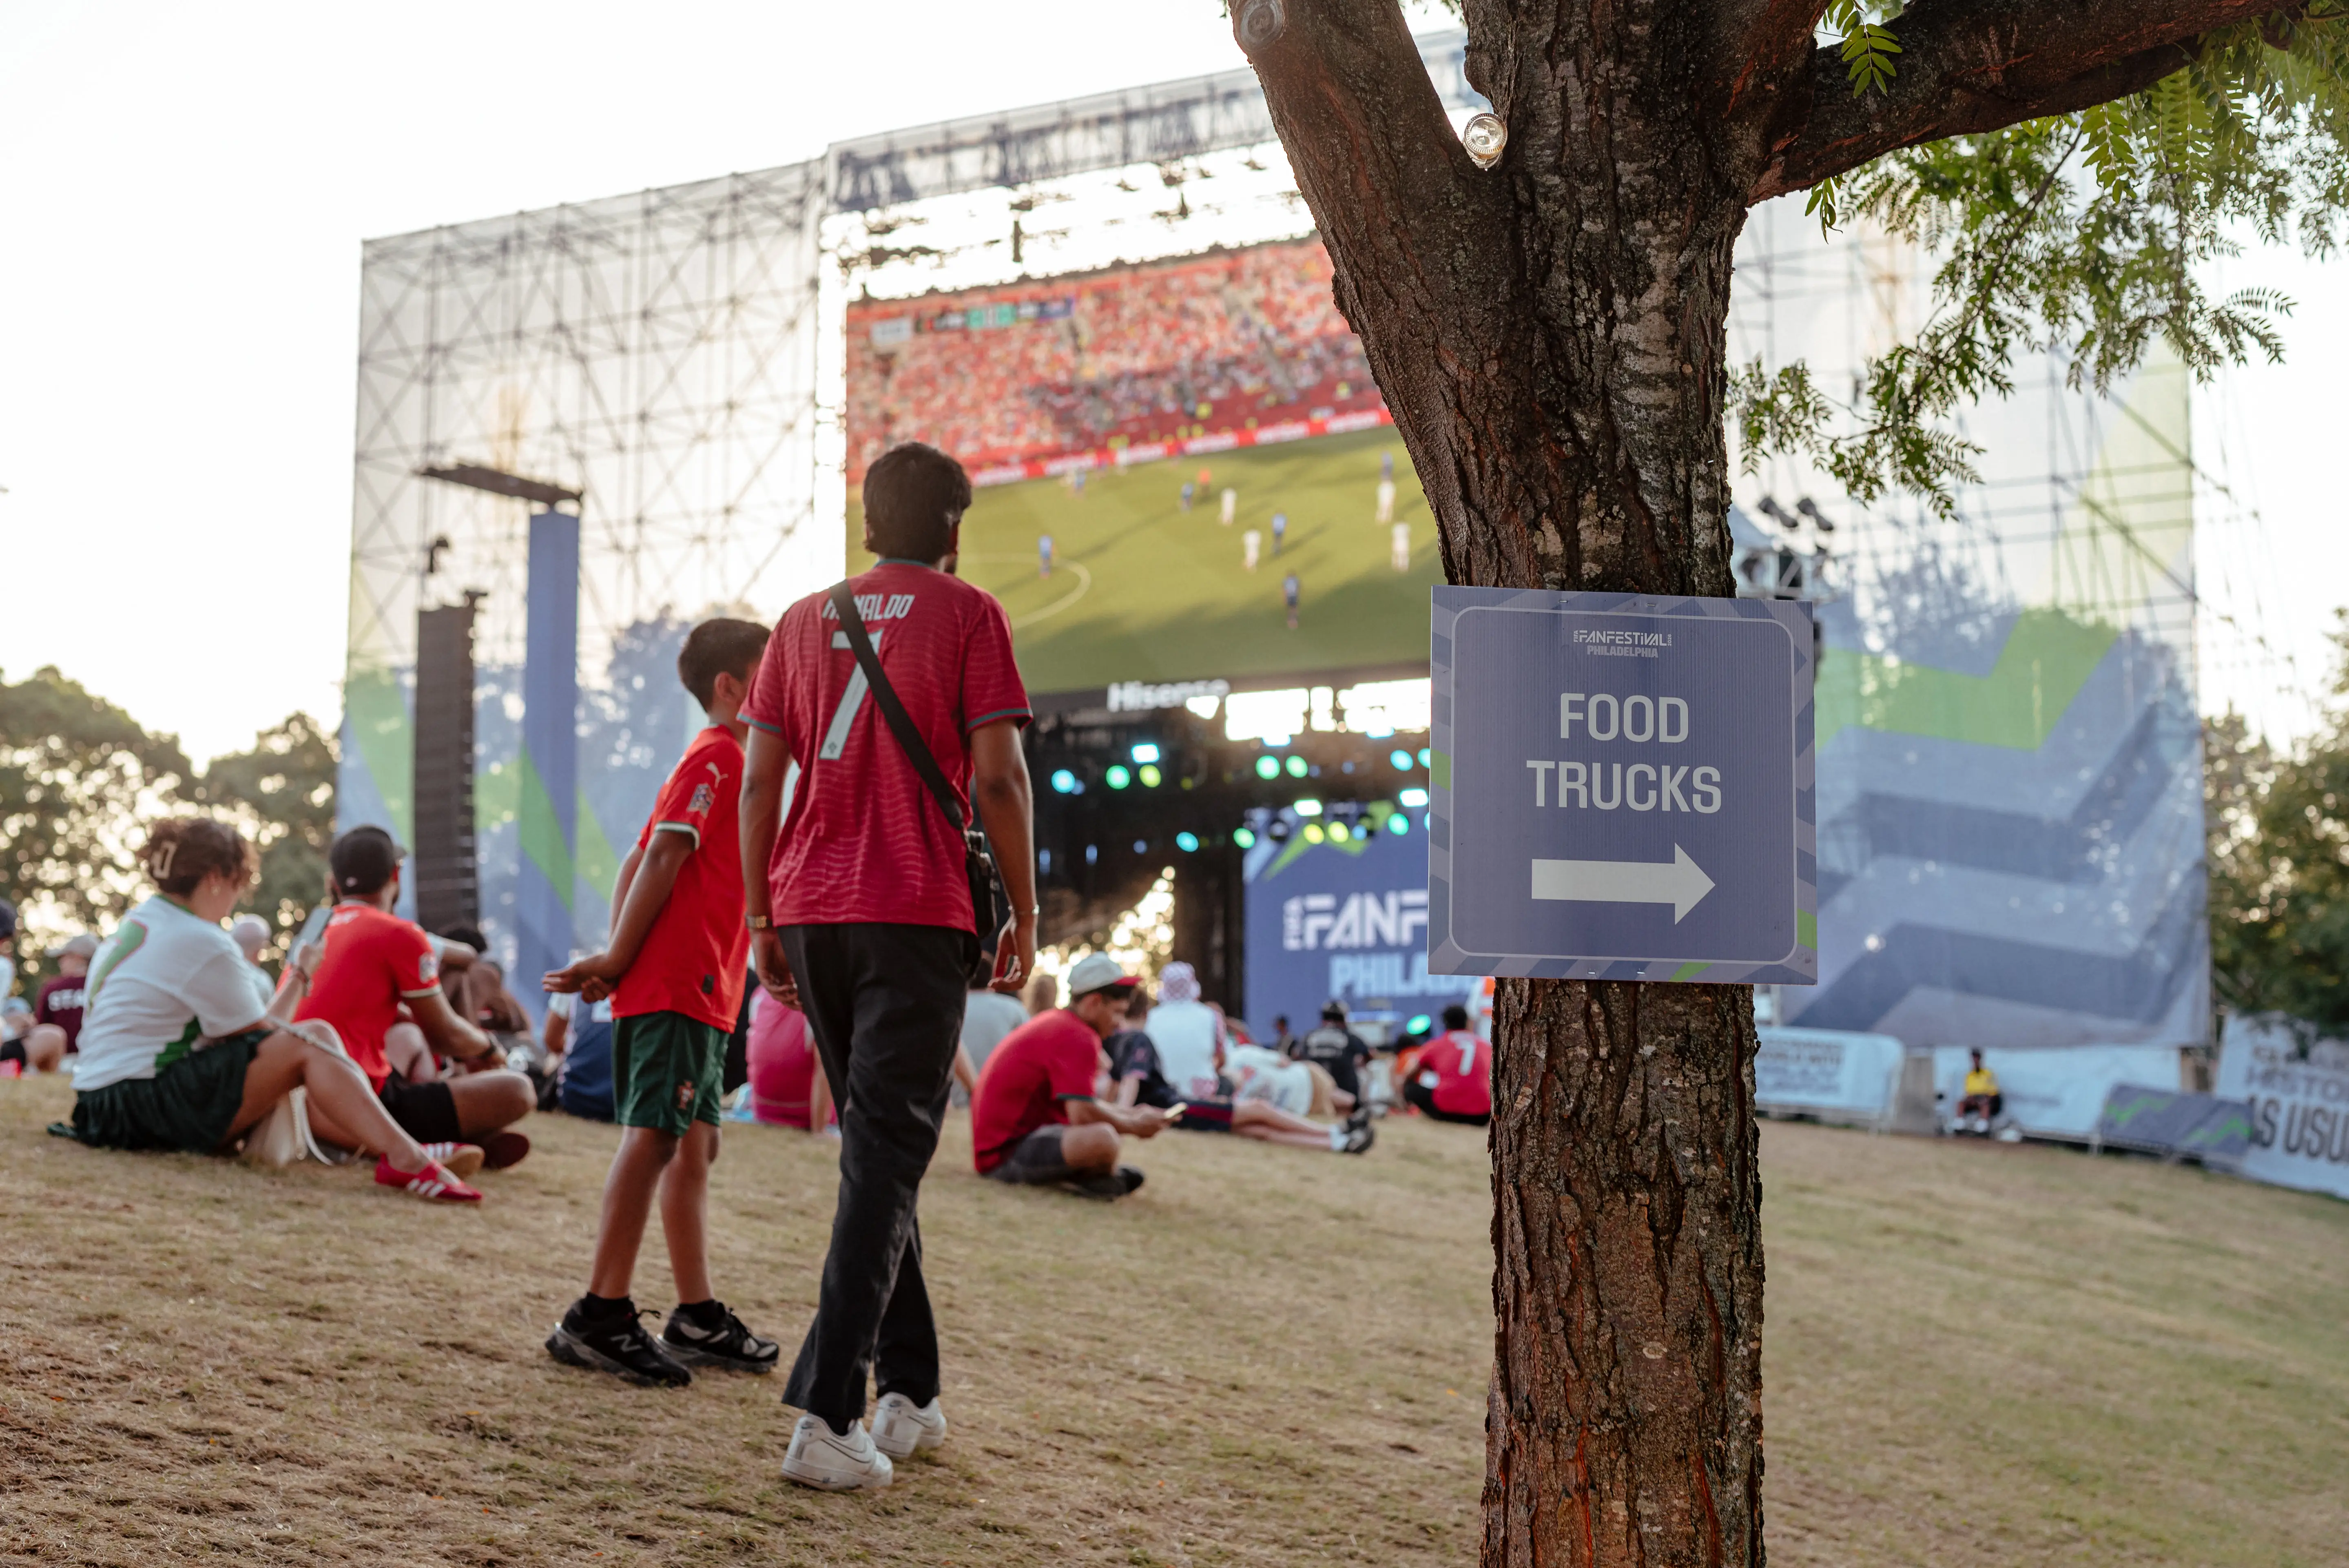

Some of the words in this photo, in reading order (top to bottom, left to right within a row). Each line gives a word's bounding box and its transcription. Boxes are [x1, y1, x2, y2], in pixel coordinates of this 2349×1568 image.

[821, 593, 916, 622] RNALDO
[1587, 645, 1658, 658] PHILADELPHIA
[818, 627, 884, 760] 7
[1560, 693, 1689, 743] FOOD
[1526, 760, 1722, 814] TRUCKS
[1455, 1039, 1477, 1076] 7
